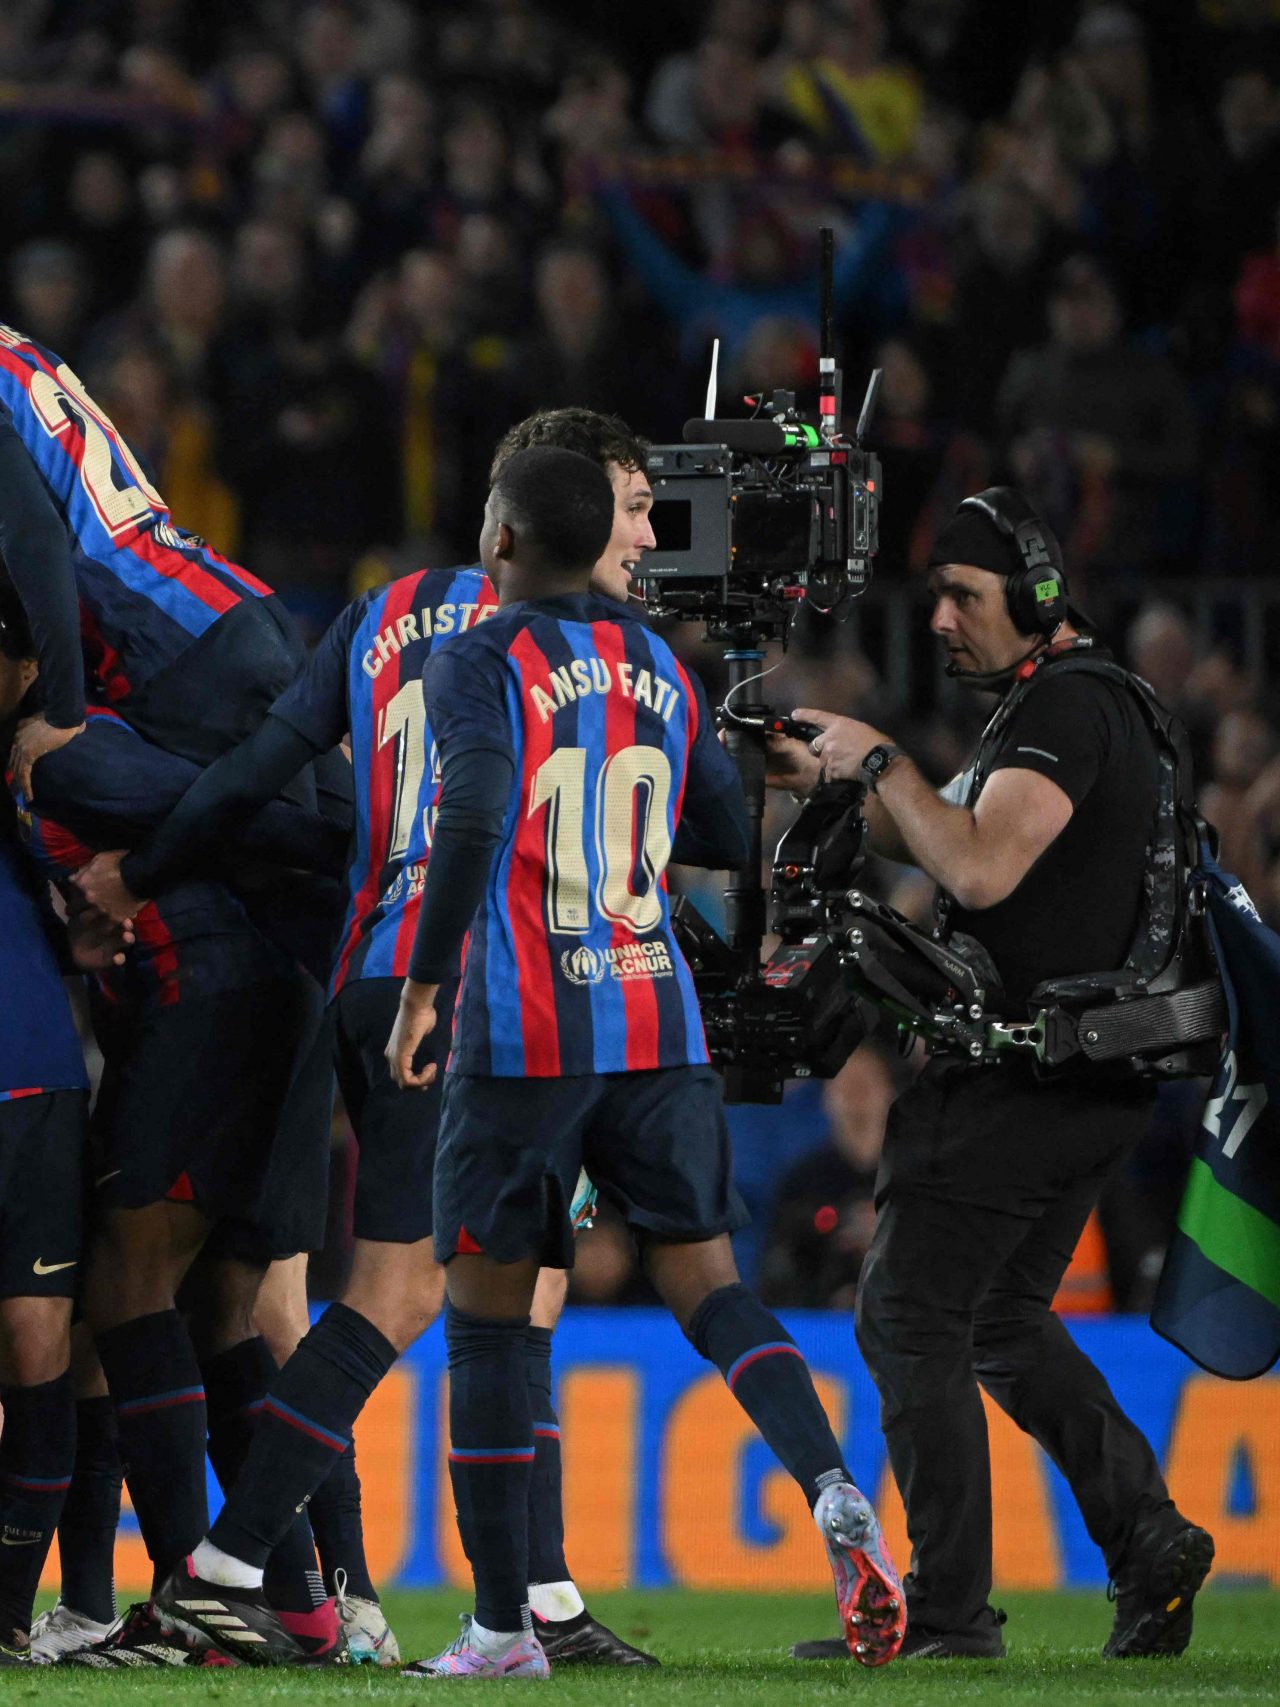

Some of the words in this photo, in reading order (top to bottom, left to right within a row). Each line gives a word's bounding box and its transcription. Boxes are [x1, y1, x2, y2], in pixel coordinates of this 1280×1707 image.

[528, 658, 612, 724] ANSU
[617, 661, 681, 722] FATI
[377, 679, 442, 863] 1
[527, 744, 672, 936] 10
[604, 941, 668, 964] UNHCR
[610, 954, 674, 978] ACNUR
